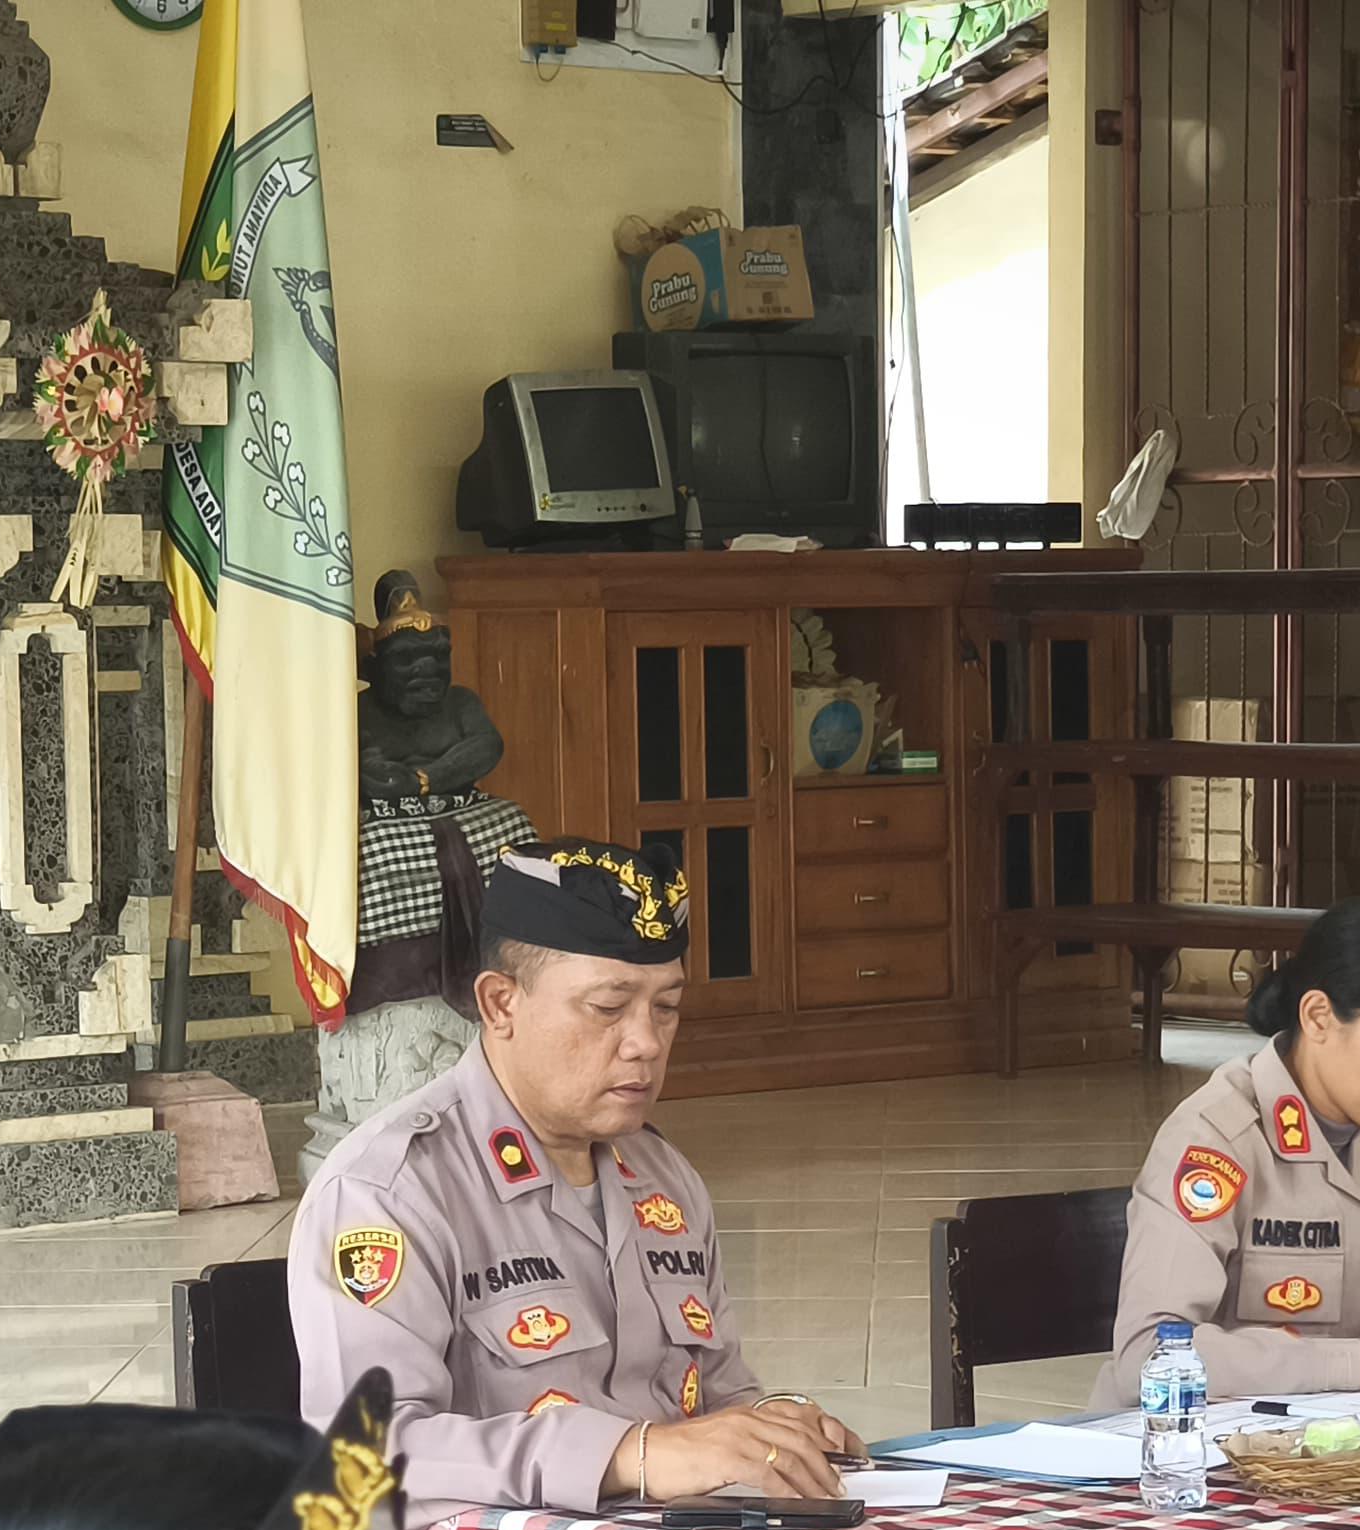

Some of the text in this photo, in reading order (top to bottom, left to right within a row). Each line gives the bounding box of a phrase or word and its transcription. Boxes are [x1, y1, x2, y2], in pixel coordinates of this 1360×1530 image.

[740, 262, 788, 275] Gunung
[745, 251, 783, 266] Prabu
[652, 274, 691, 299] Prabu
[649, 286, 697, 313] Gunung
[646, 1250, 706, 1277] POLRI
